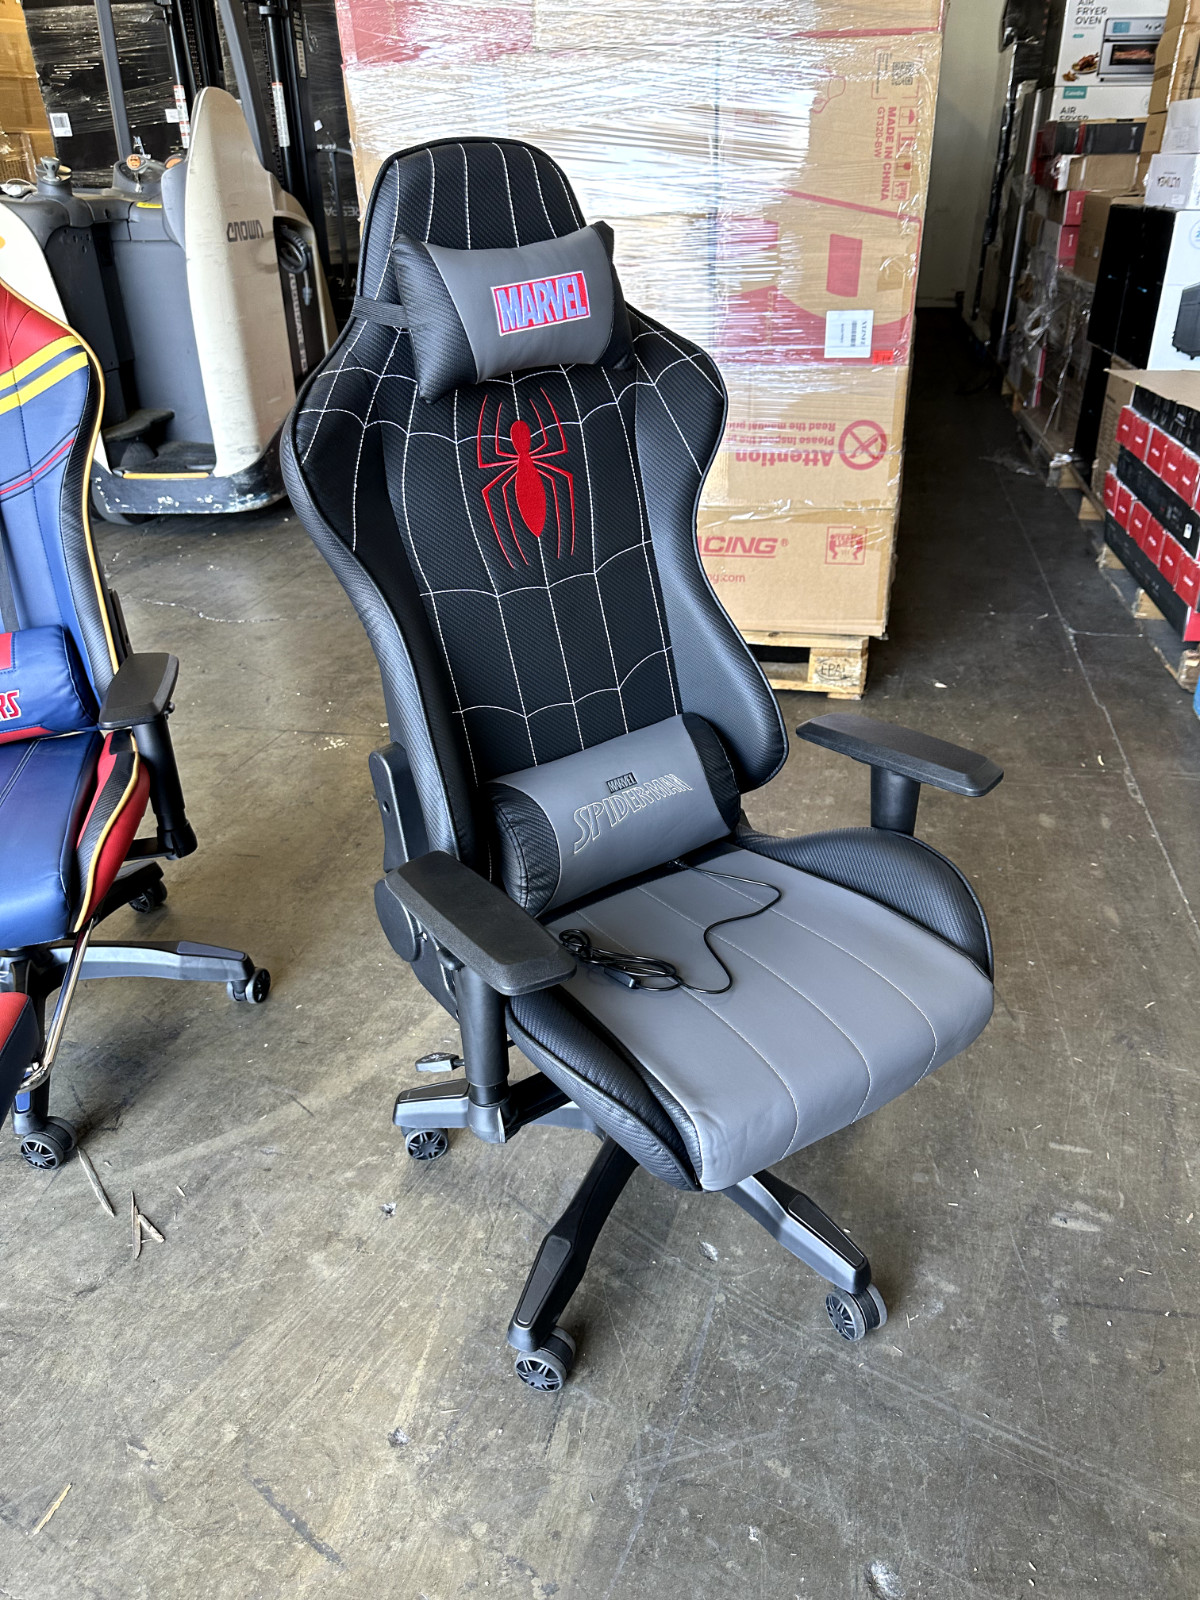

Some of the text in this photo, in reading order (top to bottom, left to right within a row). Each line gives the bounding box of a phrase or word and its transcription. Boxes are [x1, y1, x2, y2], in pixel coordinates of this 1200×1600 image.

[1076, 7, 1108, 16] FRYER
[1075, 16, 1103, 25] OVEN
[1060, 106, 1077, 114] AIR
[881, 106, 897, 201] MADE IN CHINA
[226, 219, 264, 242] CROWN
[496, 274, 588, 332] MARVEL
[788, 422, 806, 432] the
[808, 422, 836, 432] Read
[799, 436, 835, 446] Please
[735, 449, 834, 467] Attention
[697, 535, 778, 554] CING
[607, 772, 637, 793] MARVEL
